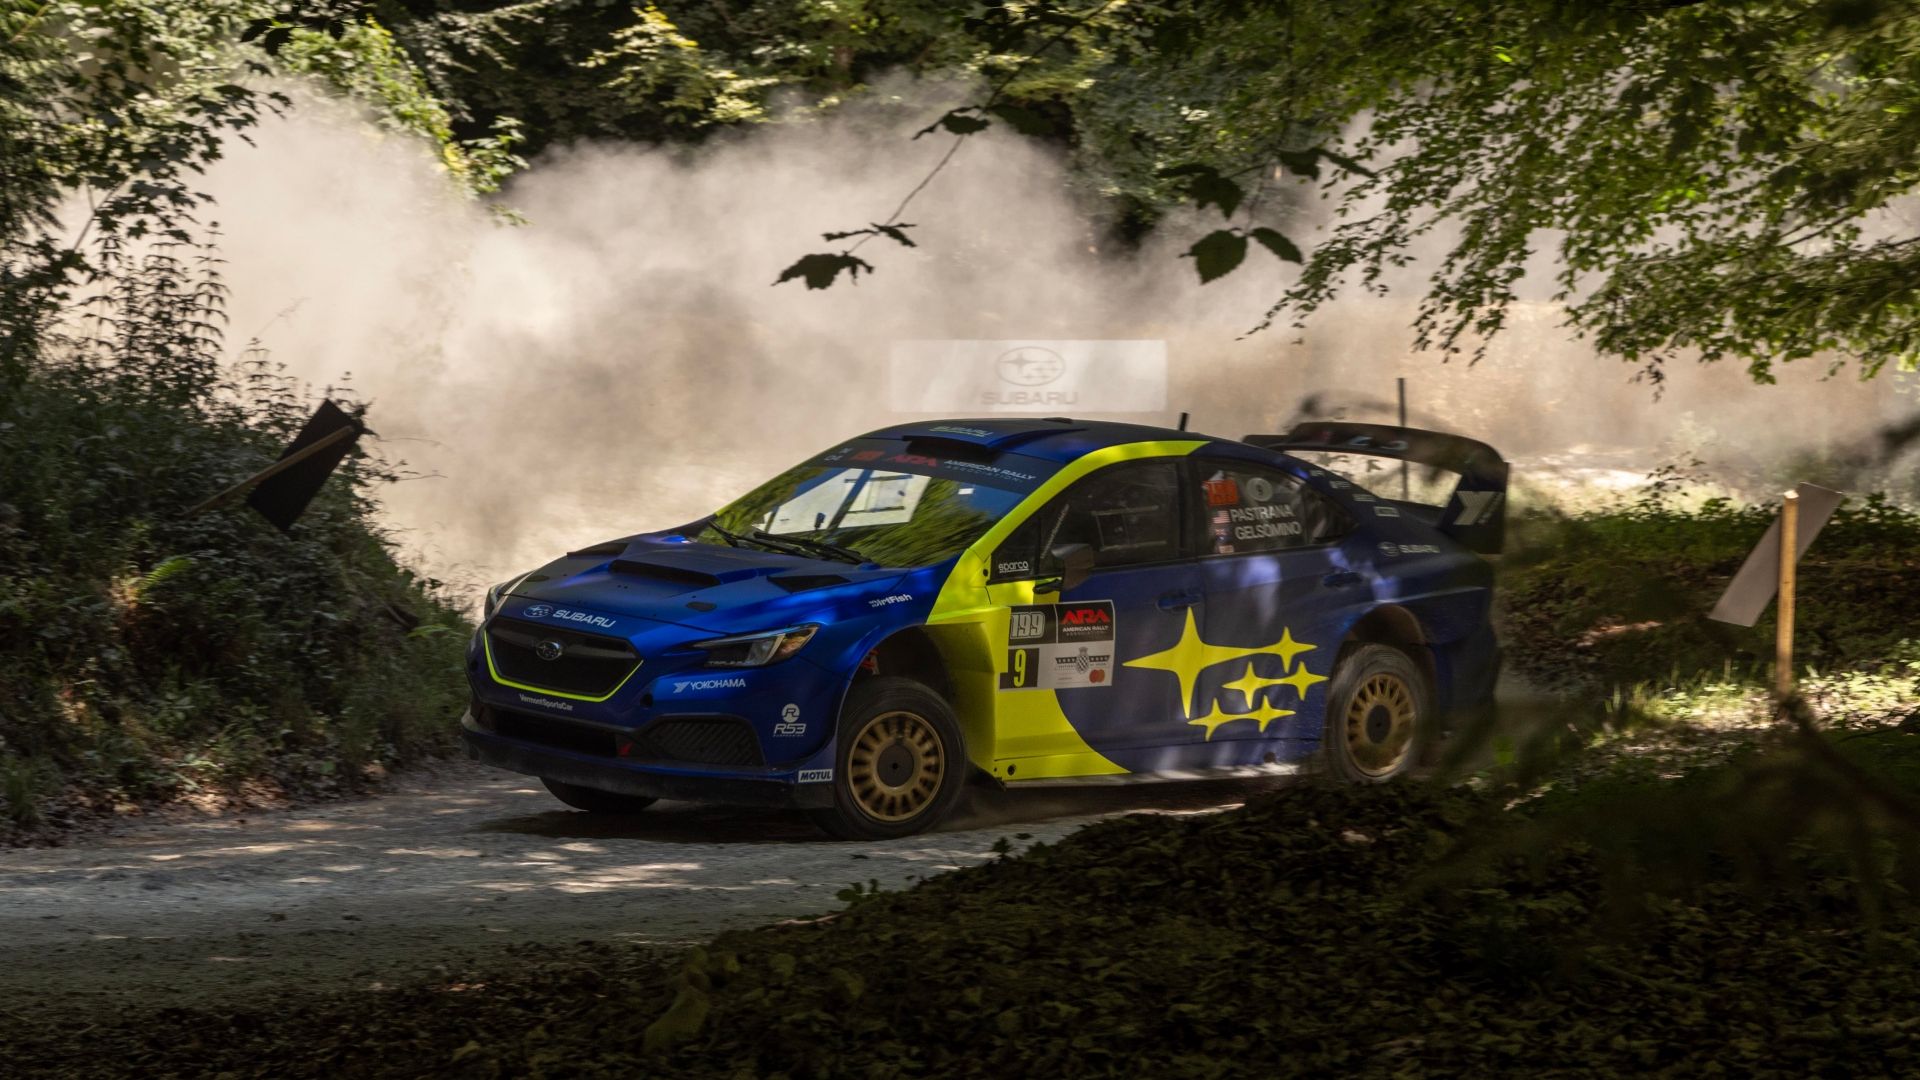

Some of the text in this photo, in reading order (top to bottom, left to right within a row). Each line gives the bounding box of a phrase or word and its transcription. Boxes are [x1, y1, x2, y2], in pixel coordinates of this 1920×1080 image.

[980, 391, 1079, 405] SUBARU
[944, 460, 1037, 480] AMERICAN RALLY
[1229, 504, 1295, 522] PASTRANA
[1235, 521, 1302, 540] GELSOMINO
[998, 560, 1029, 573] sparco
[552, 609, 616, 628] SUBARU
[1010, 611, 1045, 639] 199
[1061, 609, 1110, 625] ARA
[1062, 625, 1091, 633] AMERICAN
[1013, 649, 1027, 688] 9
[690, 678, 746, 691] YOKOHAMA
[773, 723, 806, 735] R53
[801, 770, 832, 781] MOTUL
